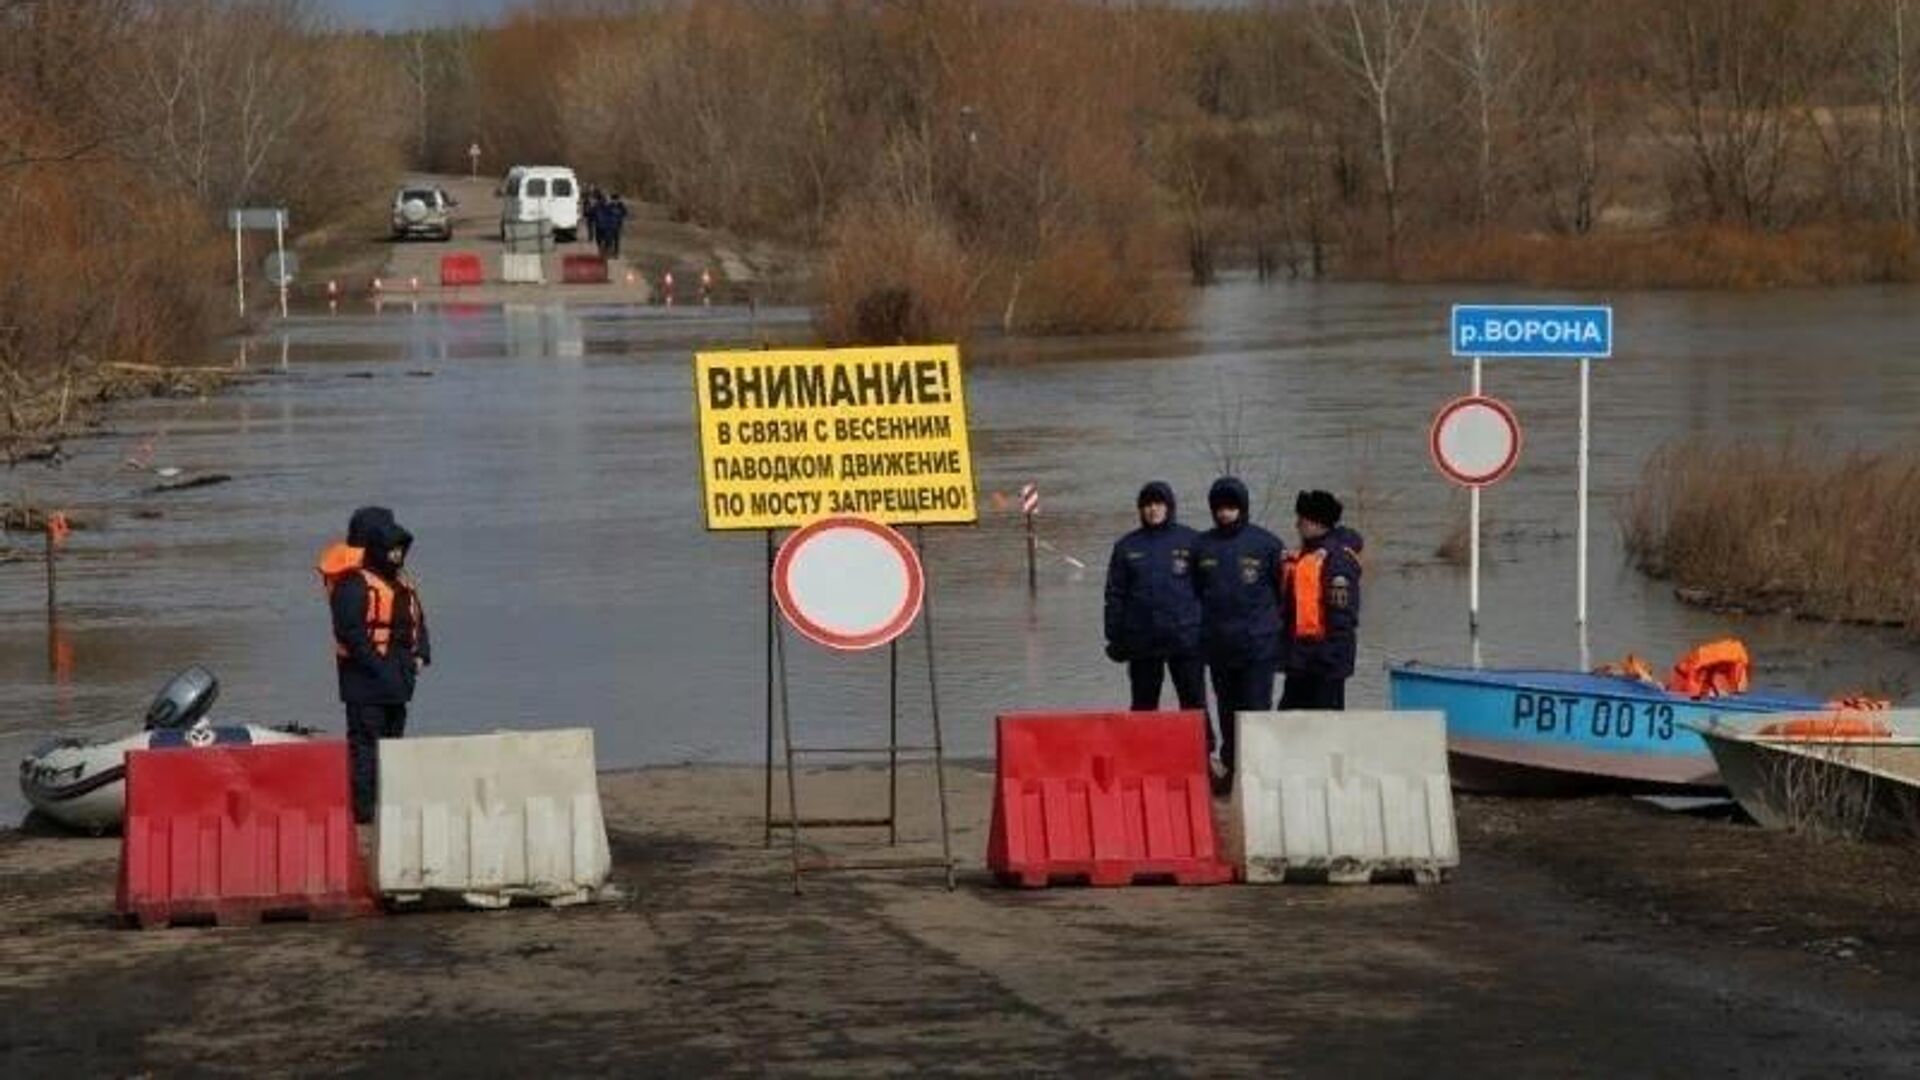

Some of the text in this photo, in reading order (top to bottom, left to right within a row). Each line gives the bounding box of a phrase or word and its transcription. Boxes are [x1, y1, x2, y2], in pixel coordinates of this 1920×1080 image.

[708, 360, 952, 409] ВНИМАНИЕ!
[717, 415, 951, 445] В СВЯЗИ С ВЕСЕННИМ
[714, 450, 961, 483] ПАВОДКОМ ДВИЖЕНИЕ
[715, 485, 967, 517] ПО МОСТУ ЗАПРЕЩЕНО!
